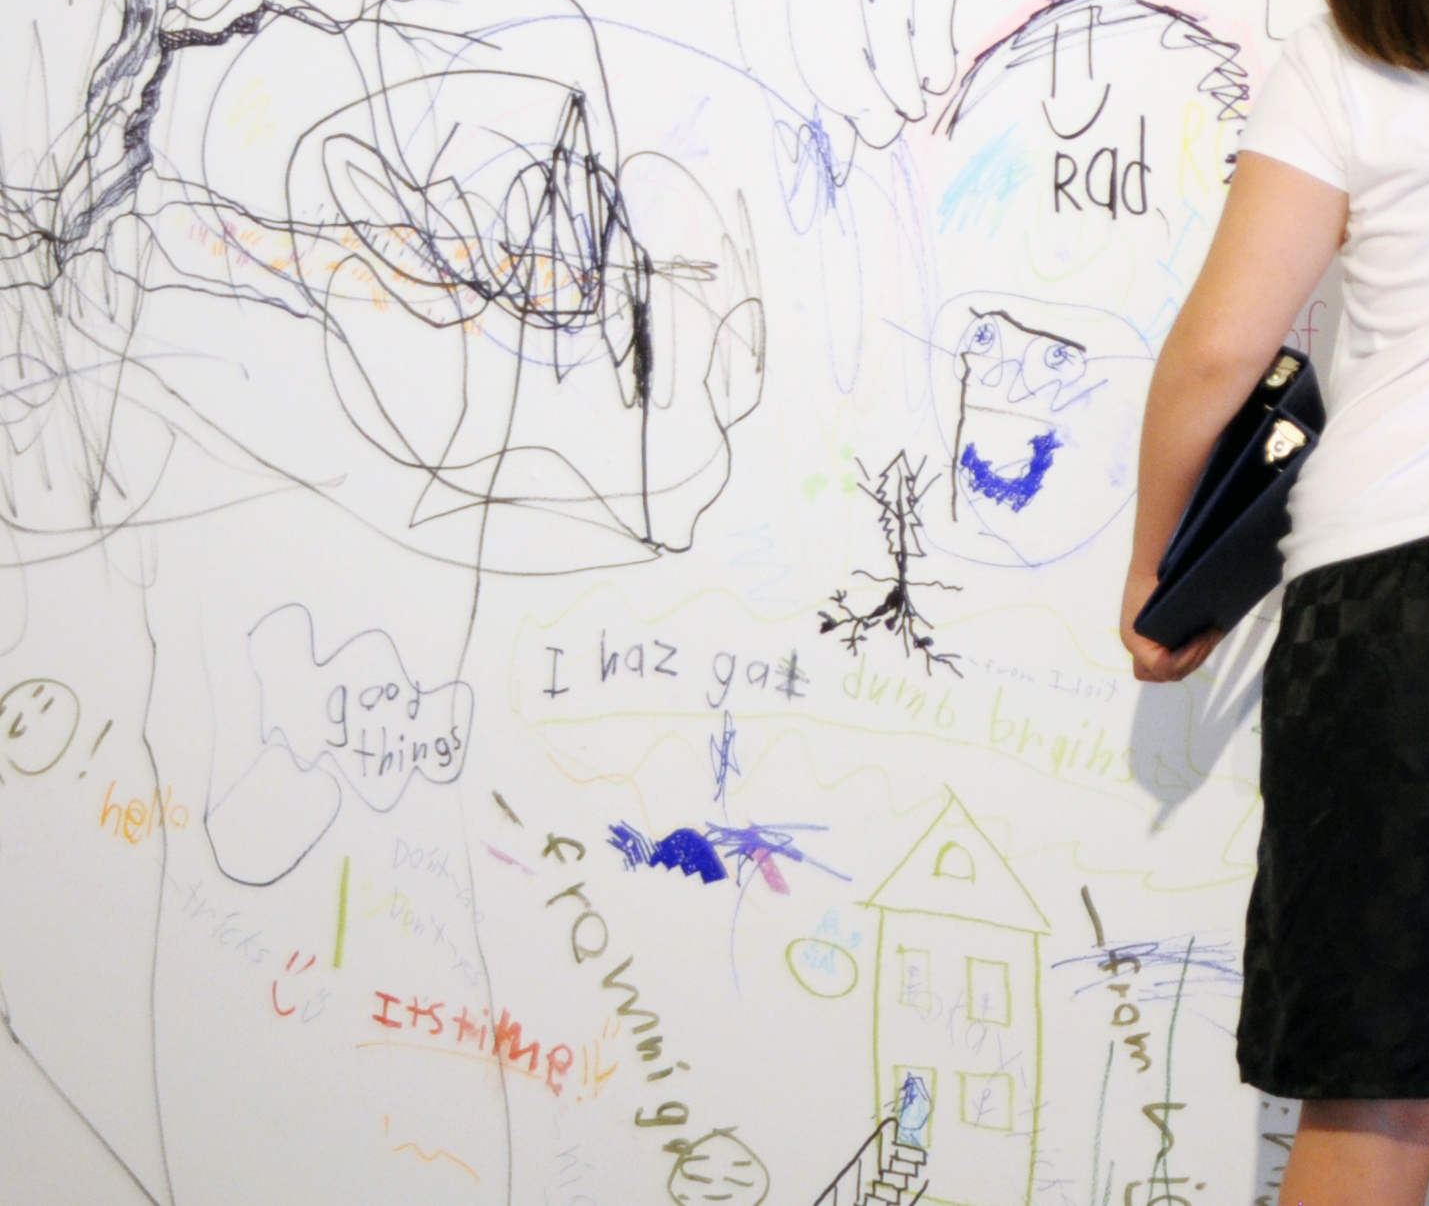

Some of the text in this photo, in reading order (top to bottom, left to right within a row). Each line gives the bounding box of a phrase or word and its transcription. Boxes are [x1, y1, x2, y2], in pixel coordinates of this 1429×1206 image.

[542, 646, 571, 698] I
[600, 628, 678, 683] haz
[326, 680, 424, 747] good
[353, 725, 462, 778] things
[99, 779, 191, 845] hello
